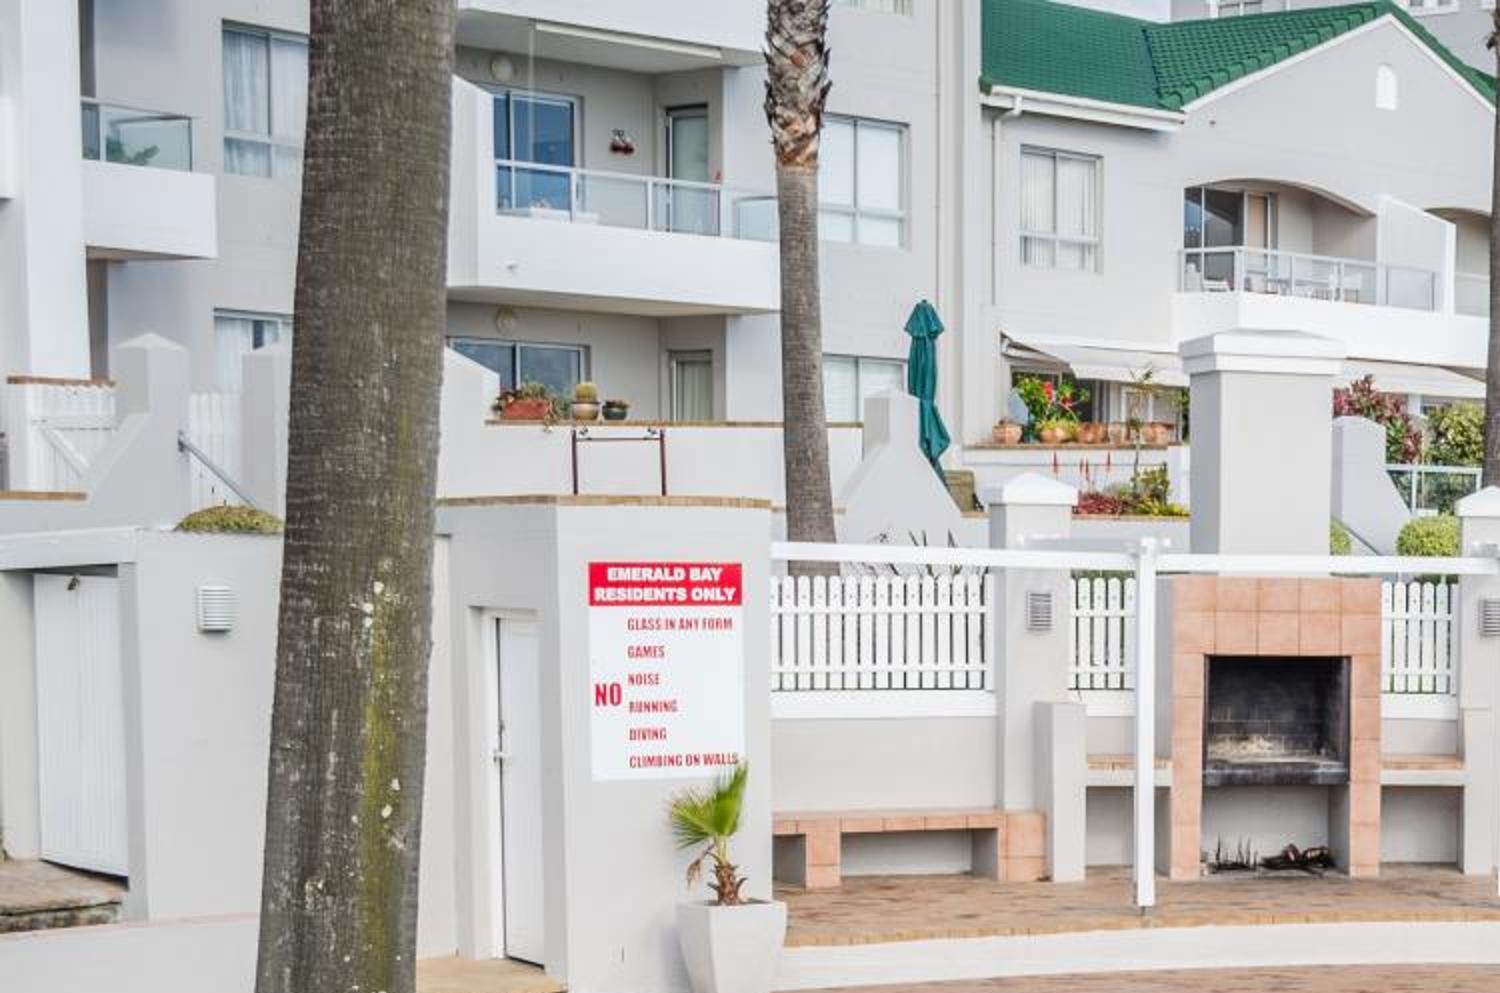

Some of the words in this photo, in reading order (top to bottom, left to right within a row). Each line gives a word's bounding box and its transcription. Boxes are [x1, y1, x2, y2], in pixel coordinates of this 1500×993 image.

[607, 568, 685, 580] EMERALD
[690, 568, 722, 580] BAY
[595, 588, 686, 601] RESIDENTS
[691, 588, 736, 601] ONLY
[627, 619, 662, 631] GLASS
[664, 619, 676, 630] IN
[678, 619, 699, 630] ANY
[702, 618, 732, 630] FORM
[628, 646, 665, 658] GAMES
[628, 674, 660, 685] NOISE
[595, 683, 621, 707] NO
[629, 700, 678, 713] RUNNING
[629, 728, 667, 740] DIVING
[629, 754, 683, 768] CLIMBING
[686, 754, 700, 766] ON
[703, 752, 738, 765] WALLS
